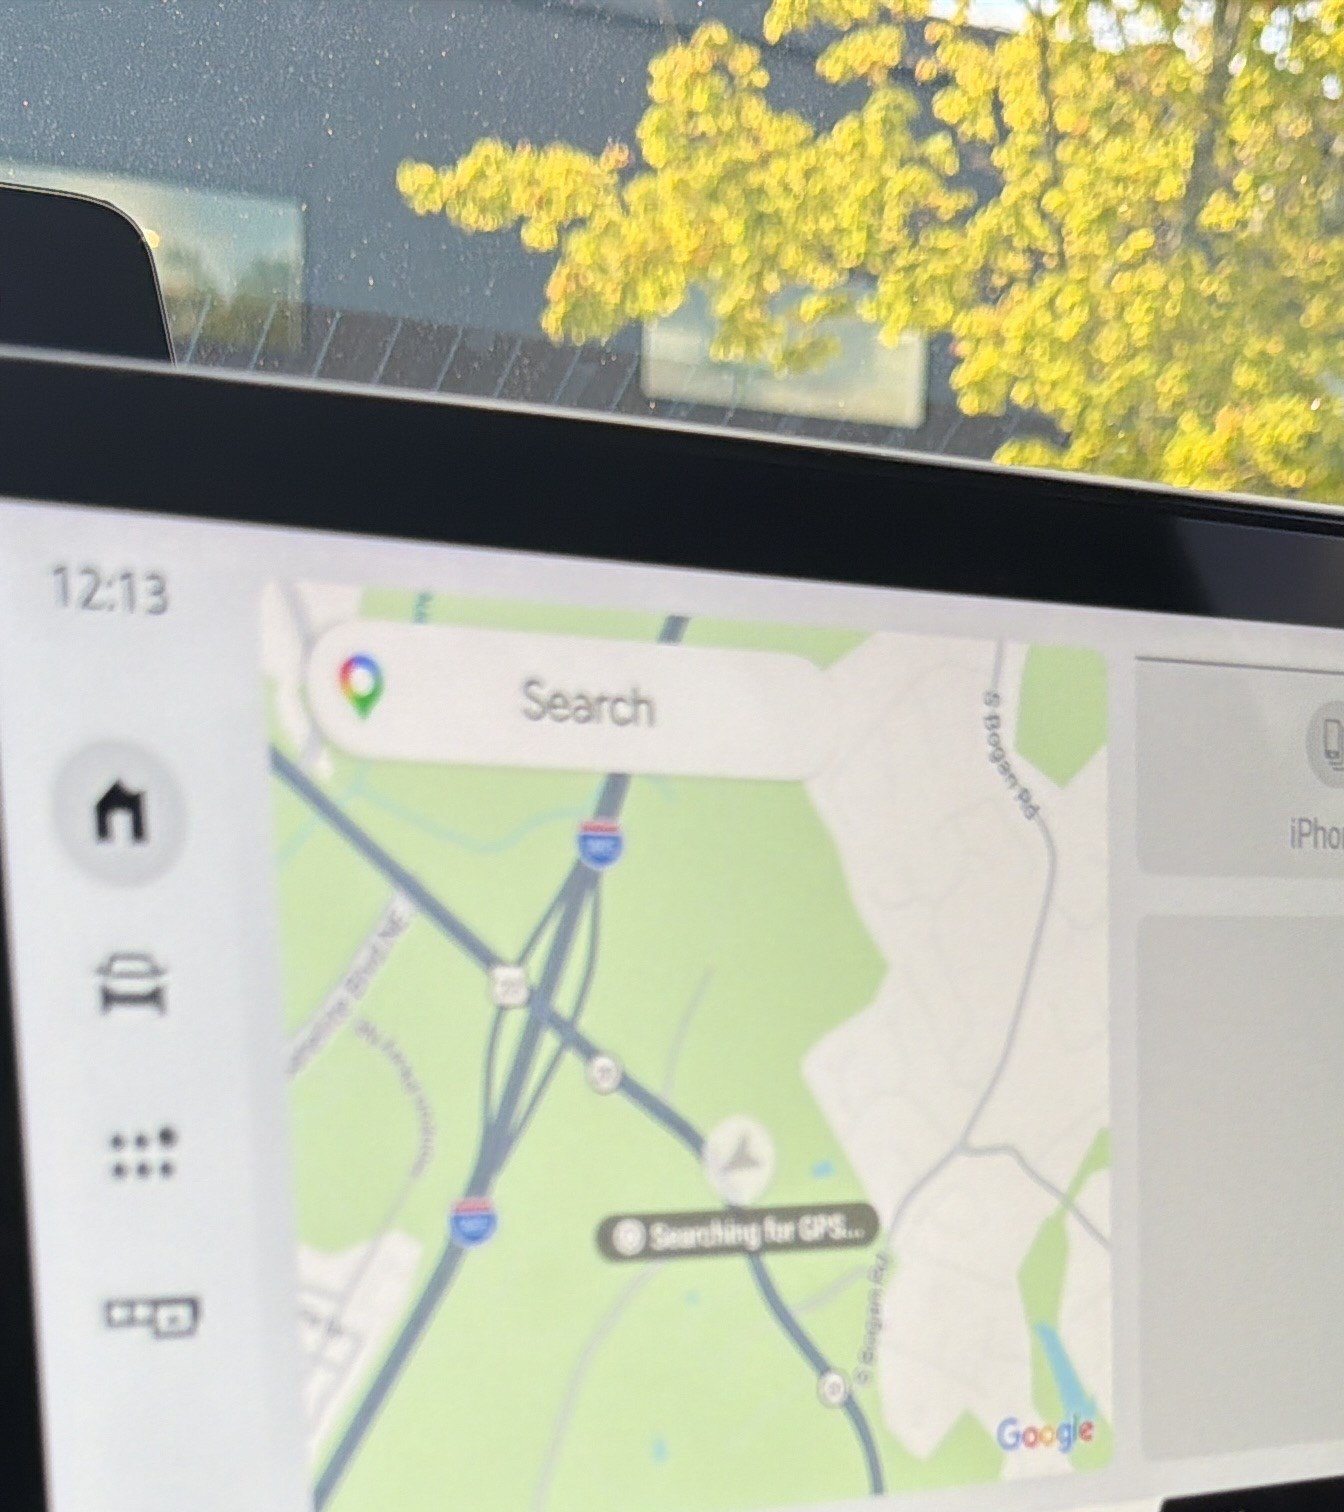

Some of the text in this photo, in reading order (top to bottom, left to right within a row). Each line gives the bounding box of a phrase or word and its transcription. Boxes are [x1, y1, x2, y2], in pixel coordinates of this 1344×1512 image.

[52, 564, 170, 617] 12:13
[521, 676, 656, 729] Search
[648, 1215, 762, 1252] Searching
[763, 1213, 796, 1244] for
[996, 1411, 1095, 1454] Google
